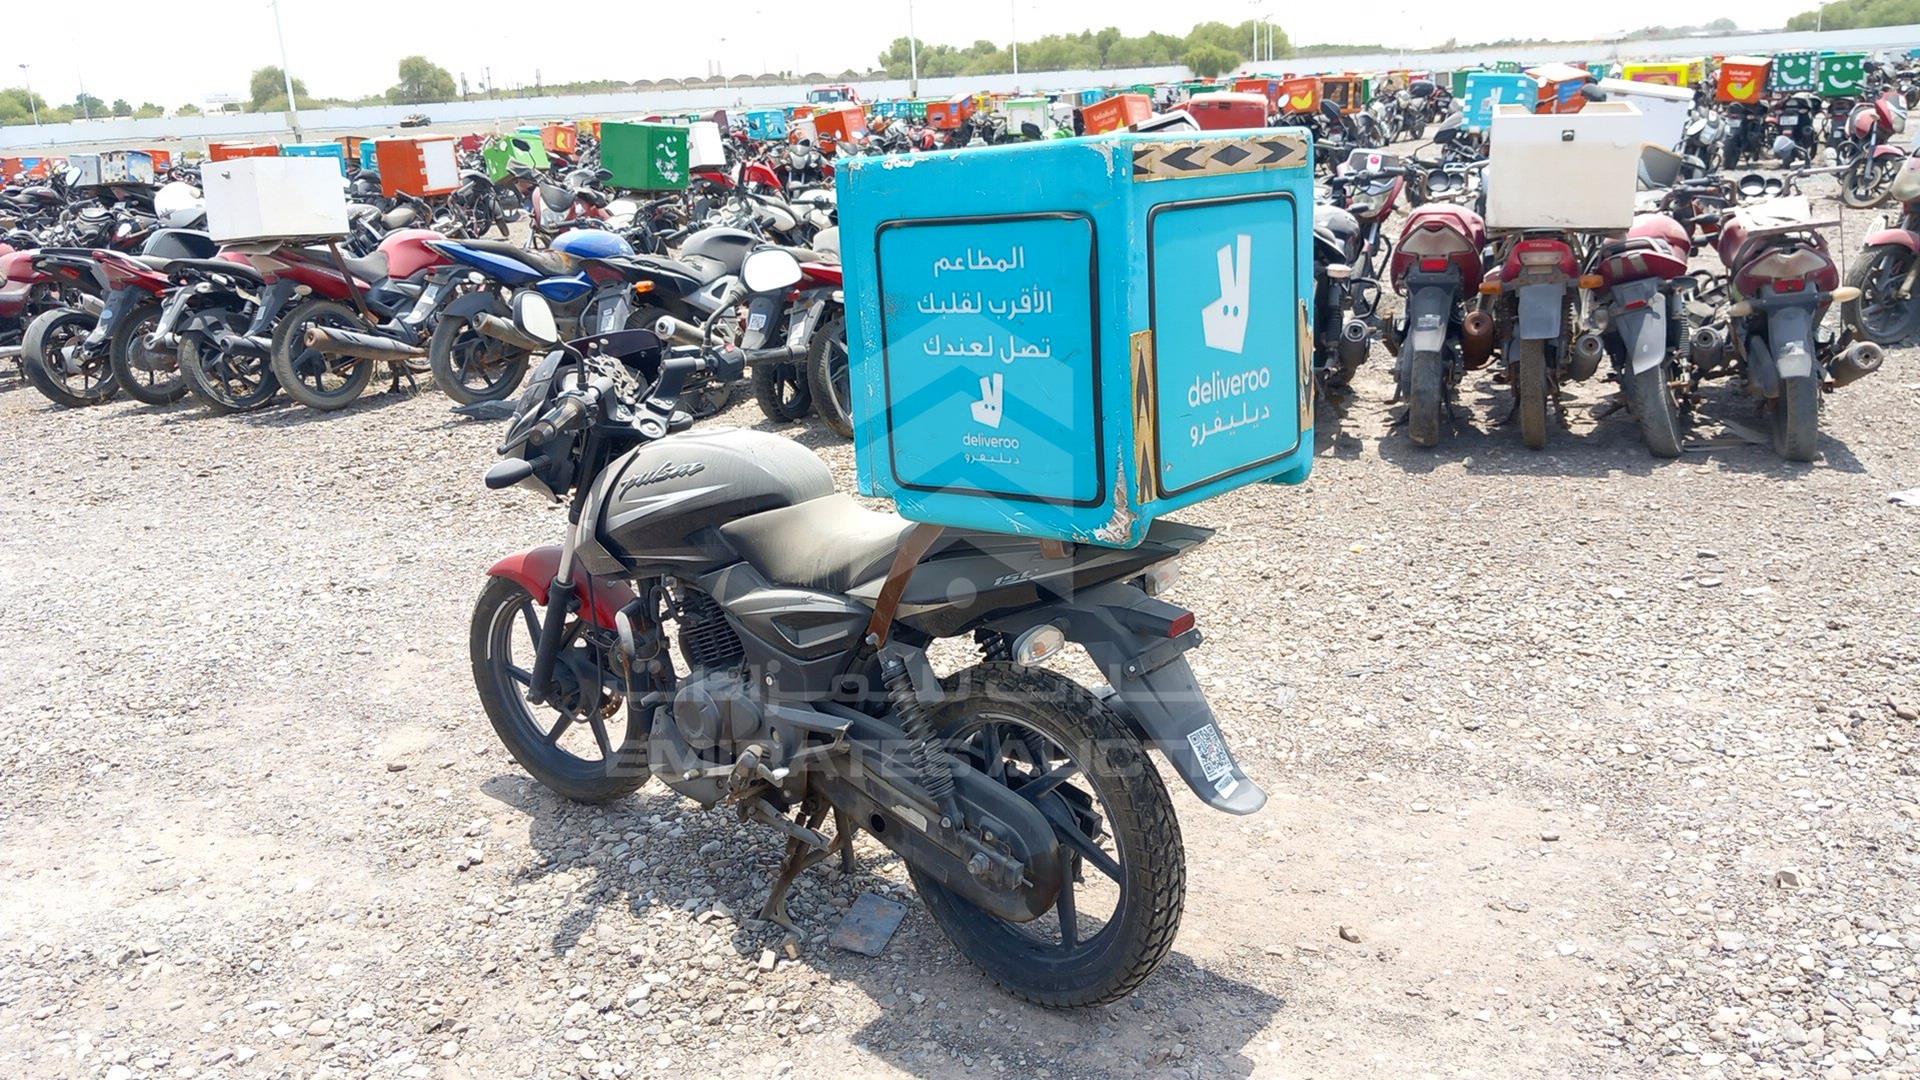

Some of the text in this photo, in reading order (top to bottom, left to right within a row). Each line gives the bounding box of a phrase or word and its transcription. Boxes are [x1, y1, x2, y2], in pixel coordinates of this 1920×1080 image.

[933, 245, 1025, 278] المطاعم
[917, 283, 1053, 320] الأقرب لقلبك
[922, 334, 1051, 364] تصل لعندك
[1188, 367, 1270, 407] deliveroo
[962, 432, 1019, 449] deliveroo
[1190, 402, 1270, 448] ديليفرو
